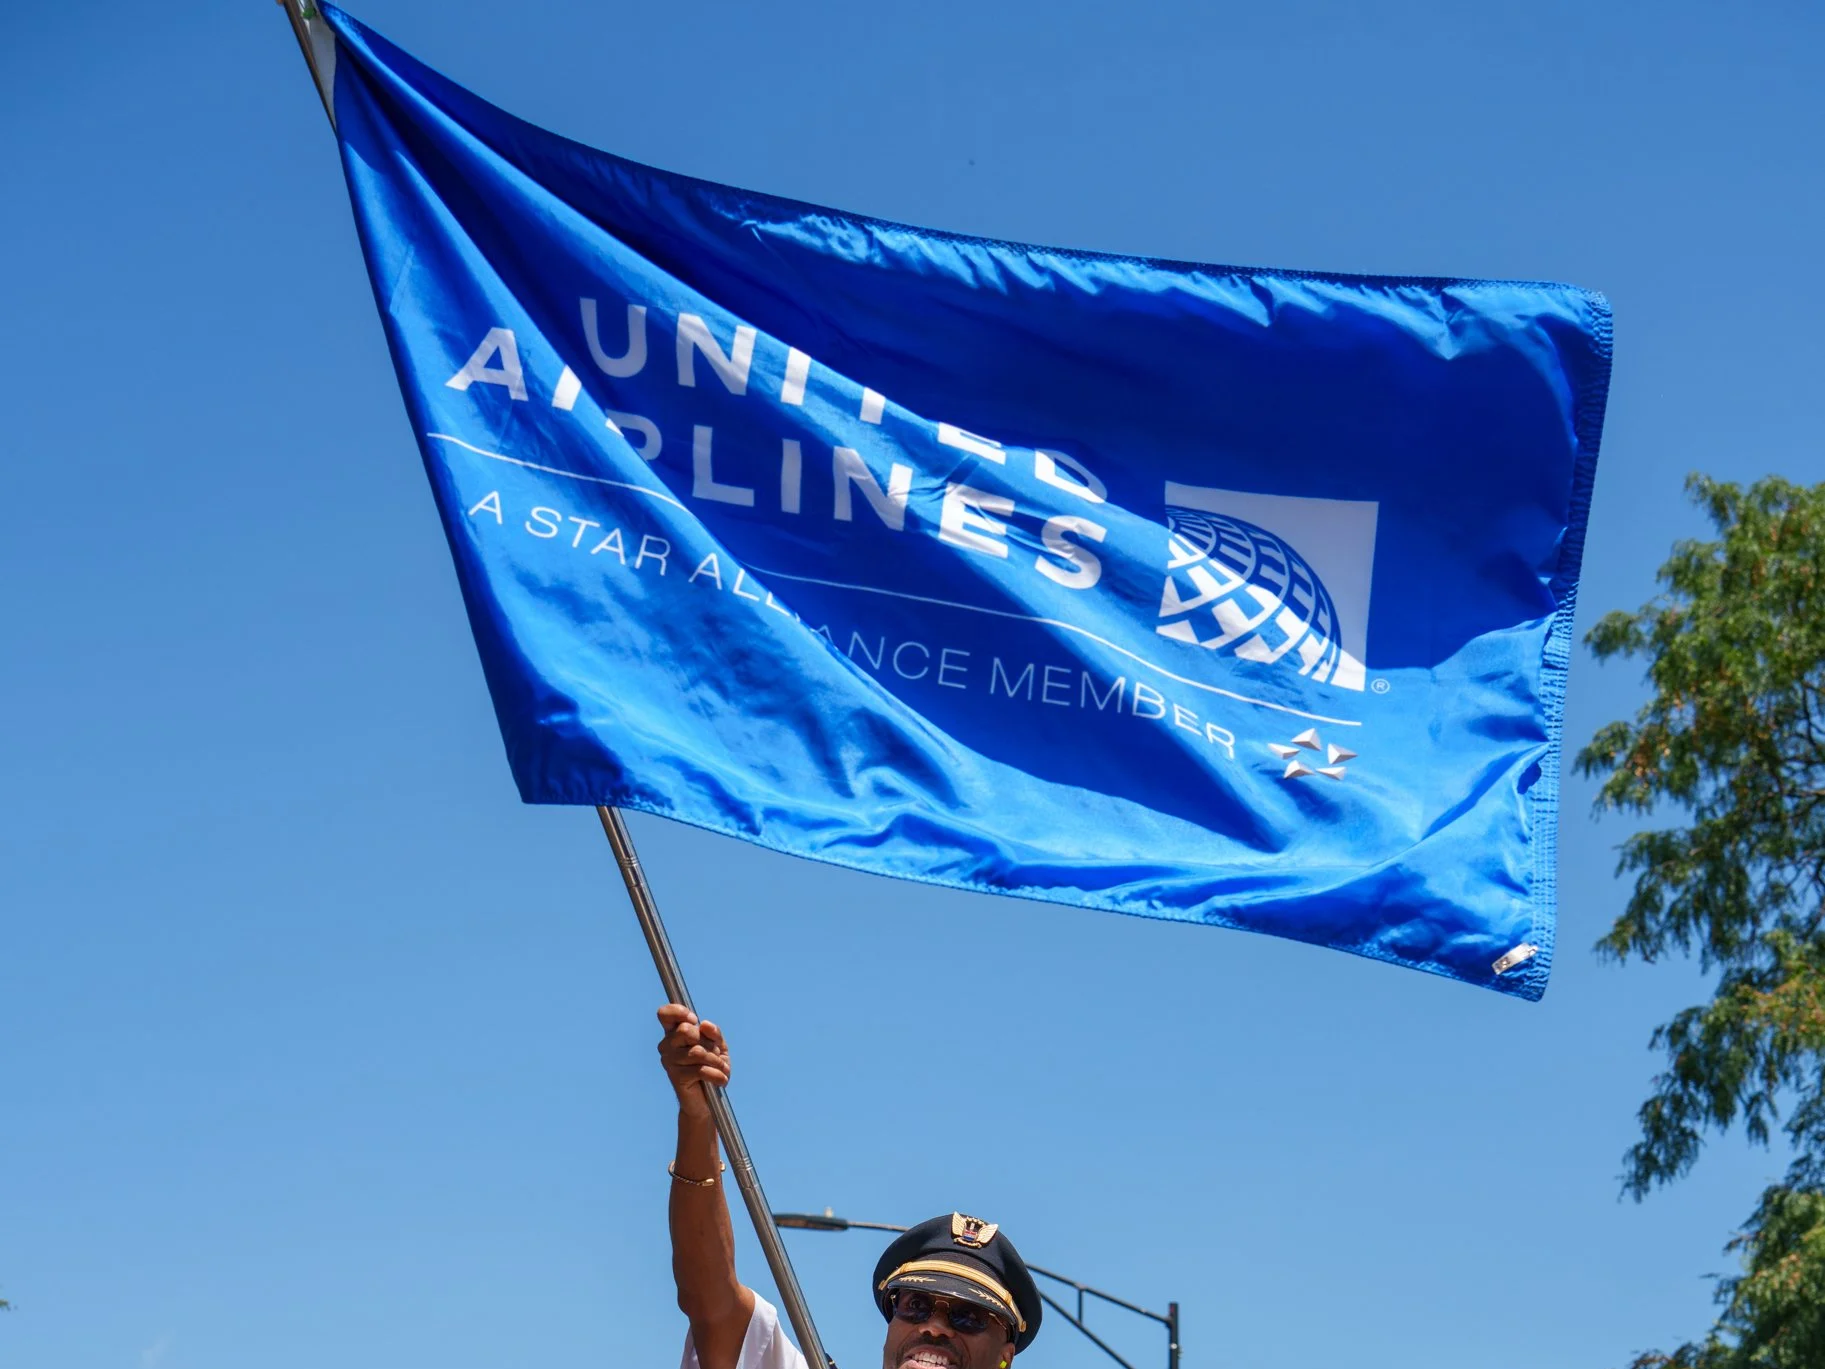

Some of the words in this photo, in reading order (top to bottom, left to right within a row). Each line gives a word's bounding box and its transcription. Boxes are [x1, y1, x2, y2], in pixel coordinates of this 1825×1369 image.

[467, 490, 503, 525] A
[525, 506, 671, 577] STAR
[688, 552, 970, 690] ALLANCE
[989, 656, 1236, 760] MEMBER
